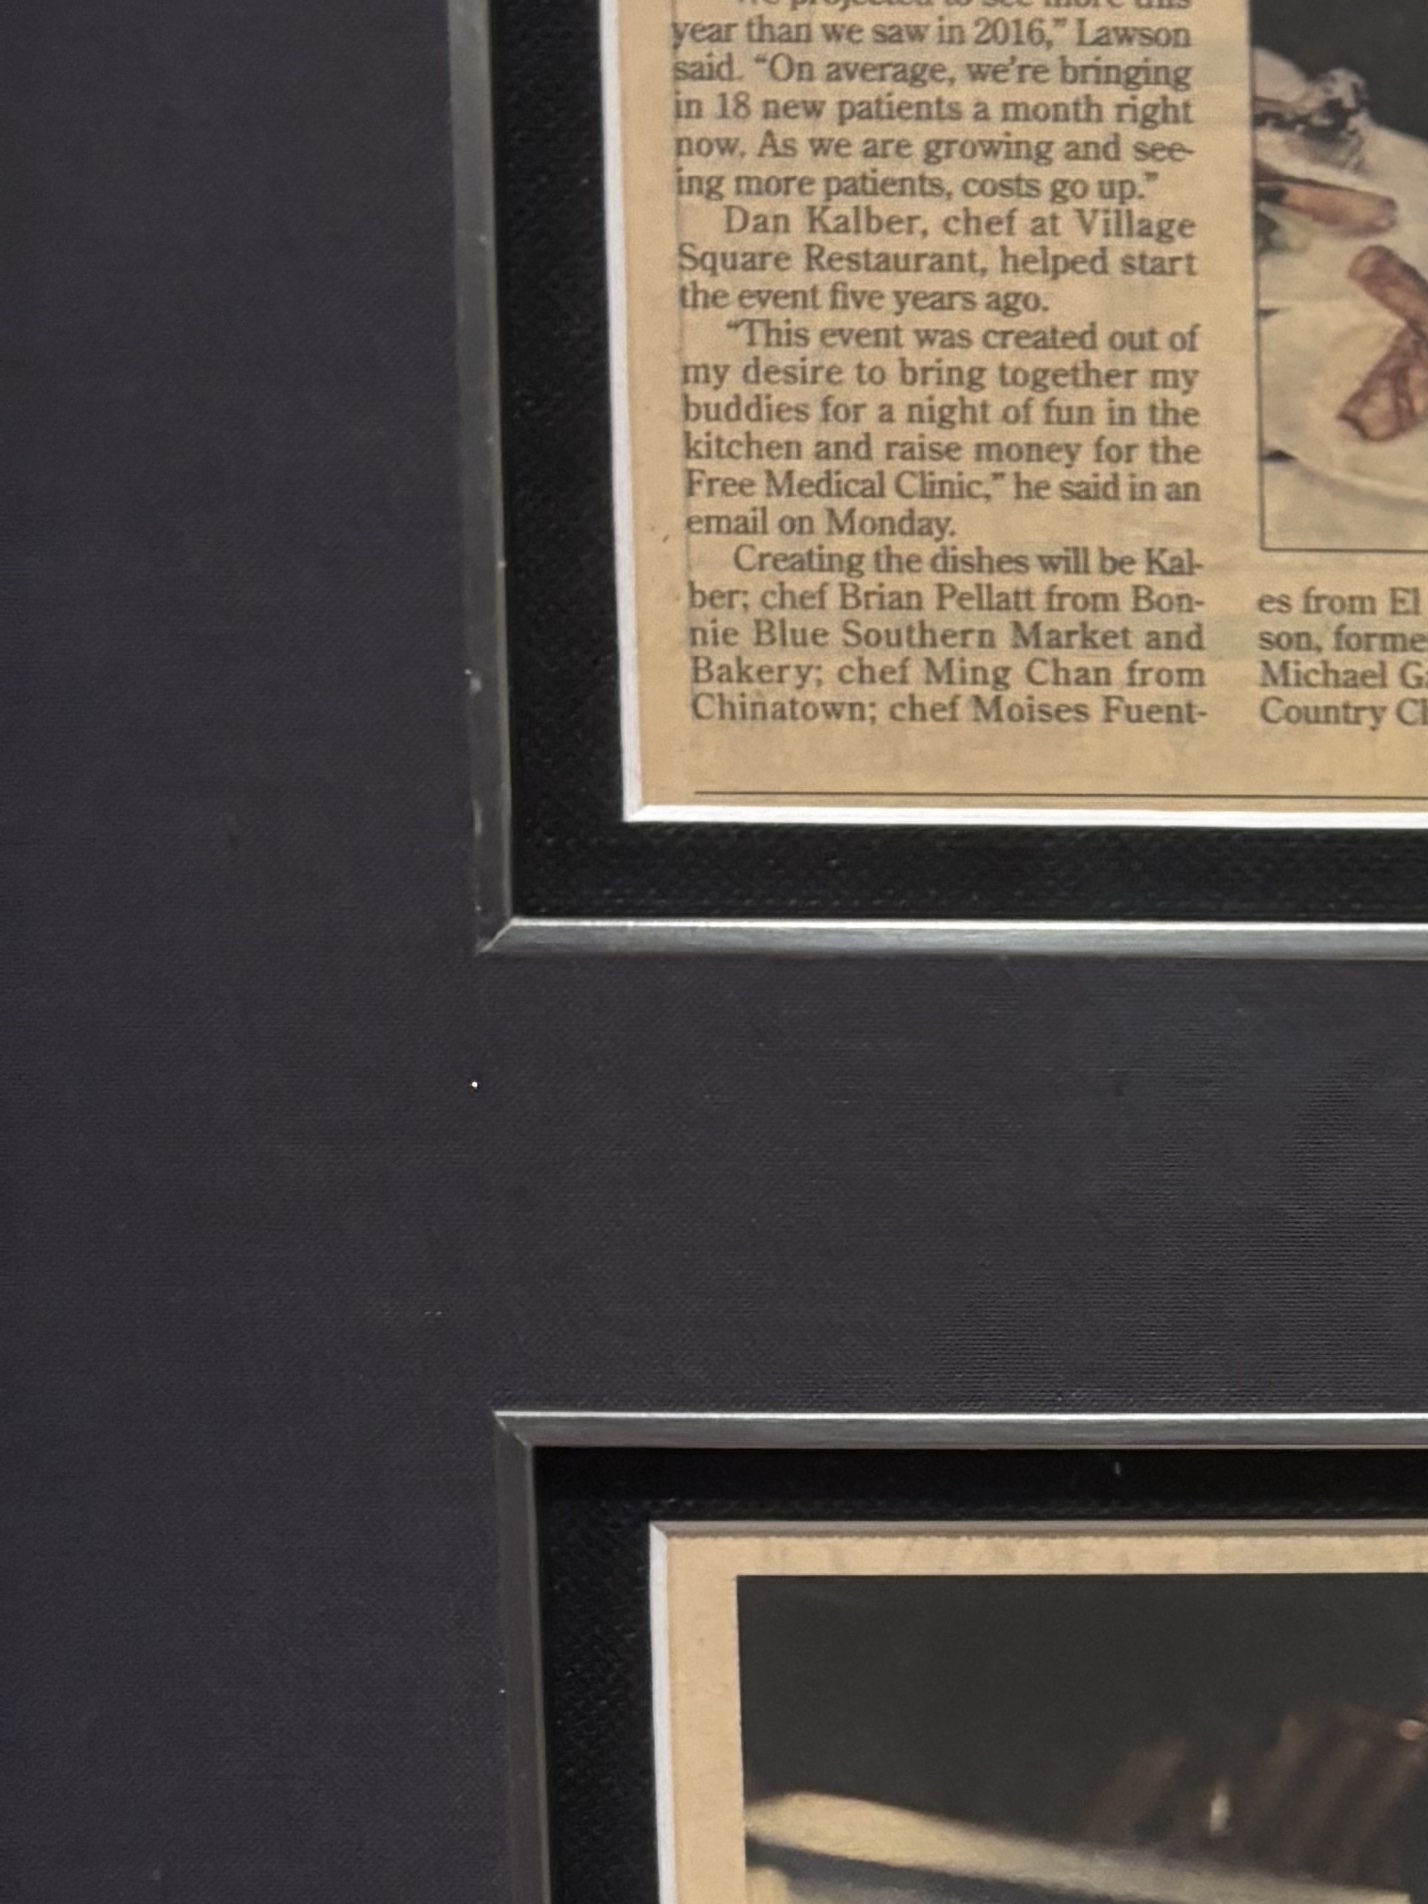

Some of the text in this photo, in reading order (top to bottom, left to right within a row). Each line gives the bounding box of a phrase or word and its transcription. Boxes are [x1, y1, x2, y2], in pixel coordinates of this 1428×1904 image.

[722, 198, 1198, 246] Dan Kalber, chef at Village
[675, 240, 1200, 283] Square Restaurant, helped start
[688, 650, 1207, 693] Bakery; chef Ming Chan from
[1257, 658, 1390, 691] Michael
[688, 687, 1208, 727] Chinatown; chef Moises Fuent-
[1258, 694, 1389, 734] Country
